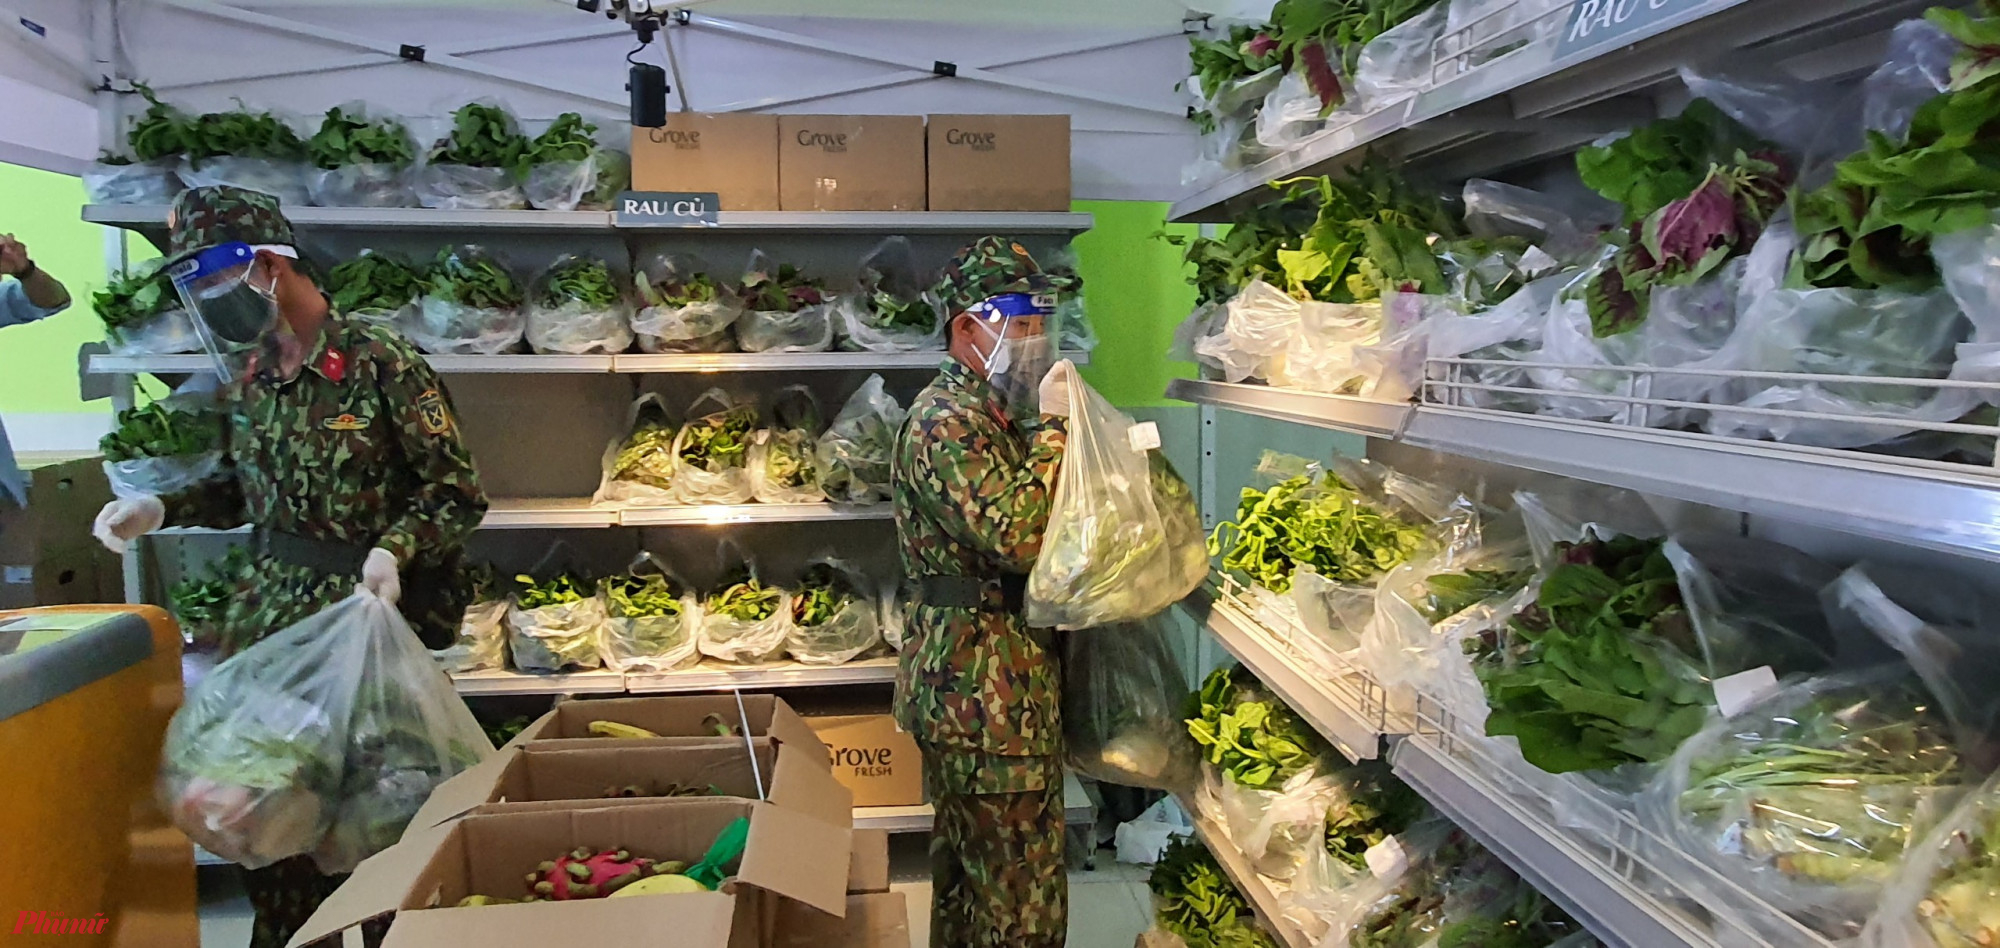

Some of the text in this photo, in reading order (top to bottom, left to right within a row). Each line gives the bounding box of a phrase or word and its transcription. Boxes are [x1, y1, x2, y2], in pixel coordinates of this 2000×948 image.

[1568, 0, 1641, 42] RAU
[649, 126, 700, 144] Grove
[797, 129, 847, 146] Grove
[946, 128, 996, 145] Grove
[624, 197, 705, 217] RAU CỦ
[854, 766, 893, 777] FRESH
